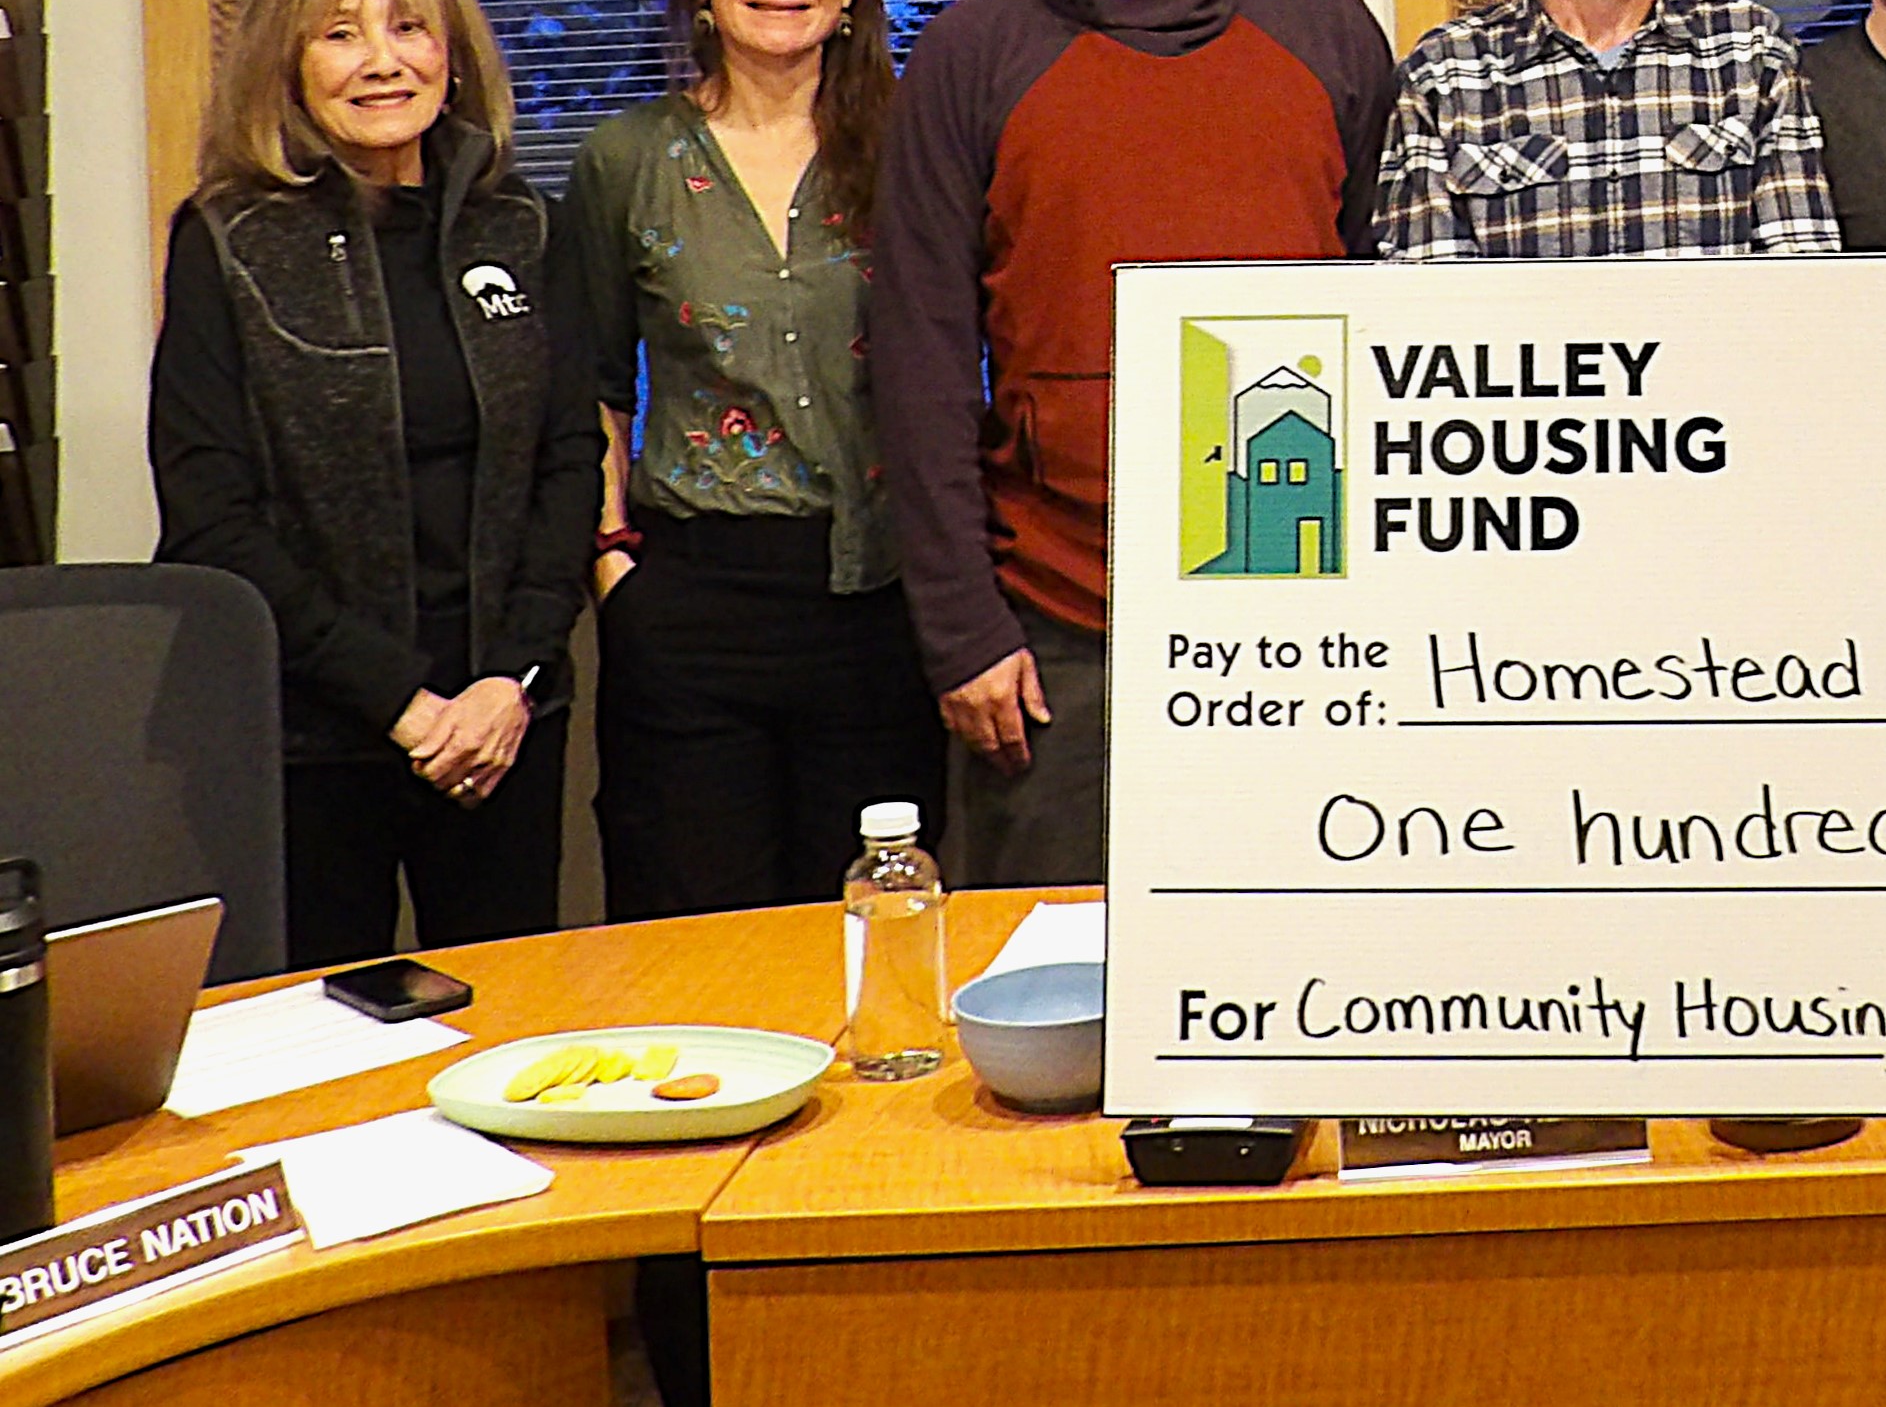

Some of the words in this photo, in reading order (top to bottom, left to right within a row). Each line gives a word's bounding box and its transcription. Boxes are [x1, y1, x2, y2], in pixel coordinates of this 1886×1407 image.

[1371, 341, 1661, 399] VALLEY
[1374, 416, 1727, 476] HOUSING
[1374, 496, 1580, 553] FUND
[1167, 633, 1242, 675] Pay
[1257, 636, 1302, 669] to
[1319, 632, 1389, 669] the
[1429, 631, 1862, 709] Homestead
[1167, 690, 1304, 727] Order
[1325, 689, 1388, 727] of:
[1317, 794, 1516, 862] One
[1179, 989, 1277, 1041] For
[1297, 977, 1646, 1061] Community
[1459, 1129, 1533, 1152] MAYOR
[0, 1238, 137, 1314] BRUCE
[140, 1188, 280, 1263] NATION
